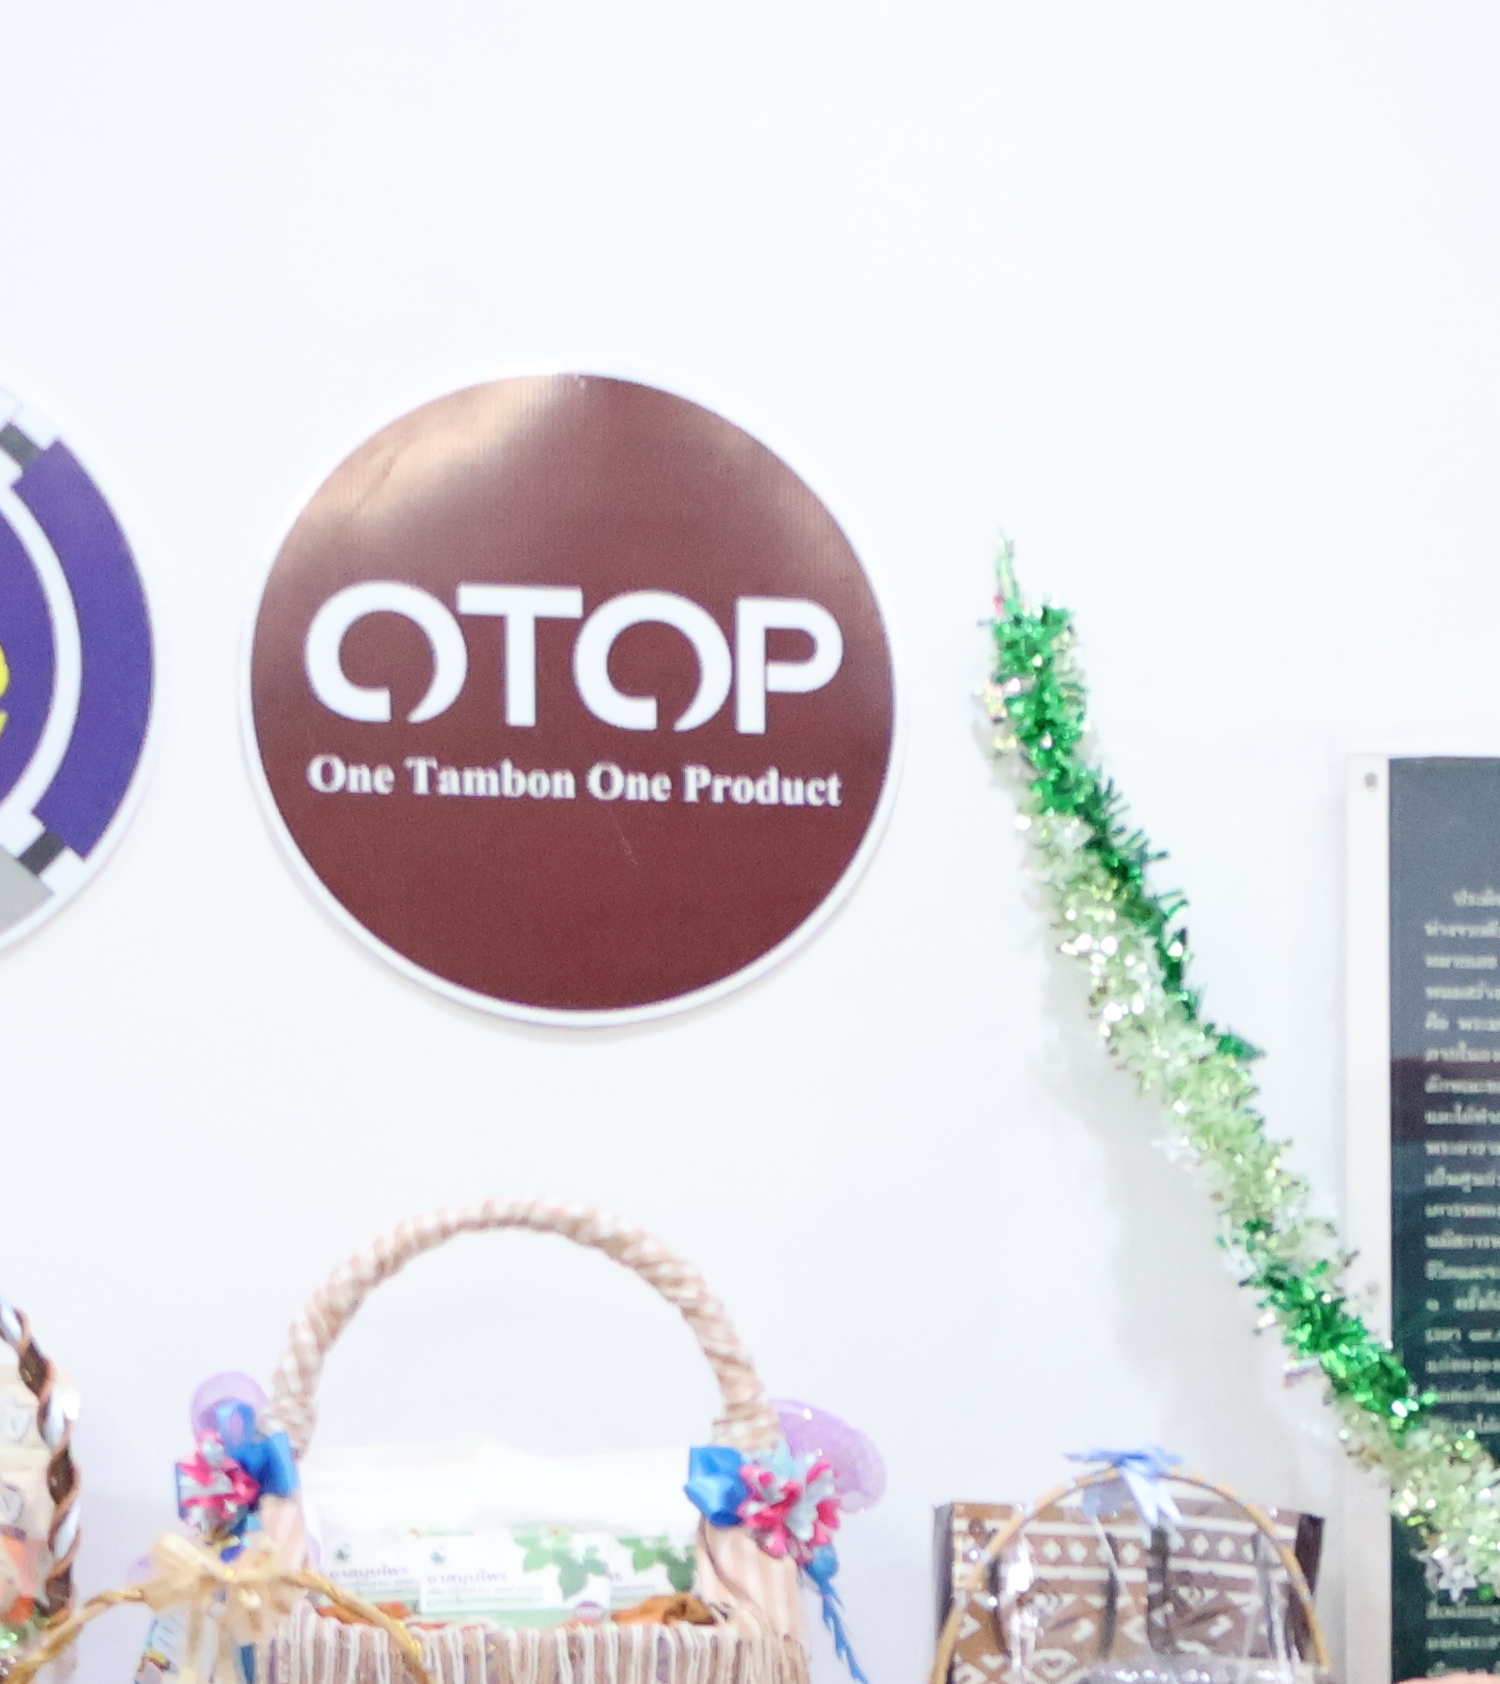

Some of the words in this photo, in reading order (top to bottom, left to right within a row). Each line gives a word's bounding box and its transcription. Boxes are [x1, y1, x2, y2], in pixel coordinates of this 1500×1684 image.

[304, 580, 844, 734] OTOP
[307, 753, 395, 795] One
[404, 755, 576, 799] Tambon
[587, 761, 673, 802] One
[684, 763, 842, 807] Product
